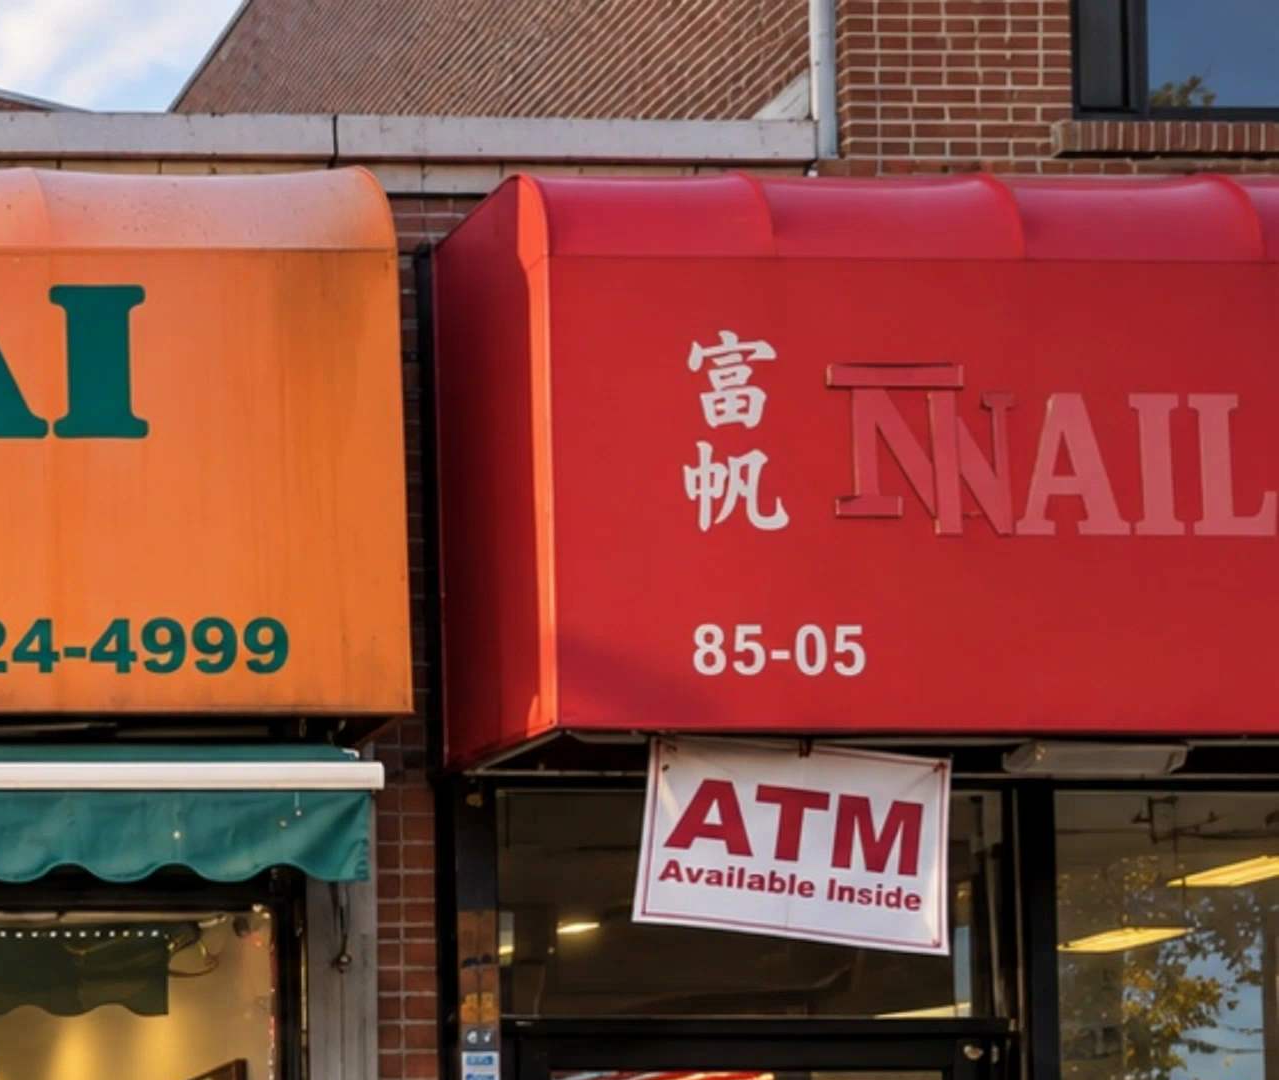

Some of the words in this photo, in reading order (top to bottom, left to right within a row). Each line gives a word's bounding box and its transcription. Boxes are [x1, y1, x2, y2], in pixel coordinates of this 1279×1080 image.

[682, 330, 790, 532] 富帆
[692, 623, 867, 677] 85-05
[662, 778, 925, 878] ATM
[658, 858, 817, 898] Available
[826, 877, 923, 912] Inside
